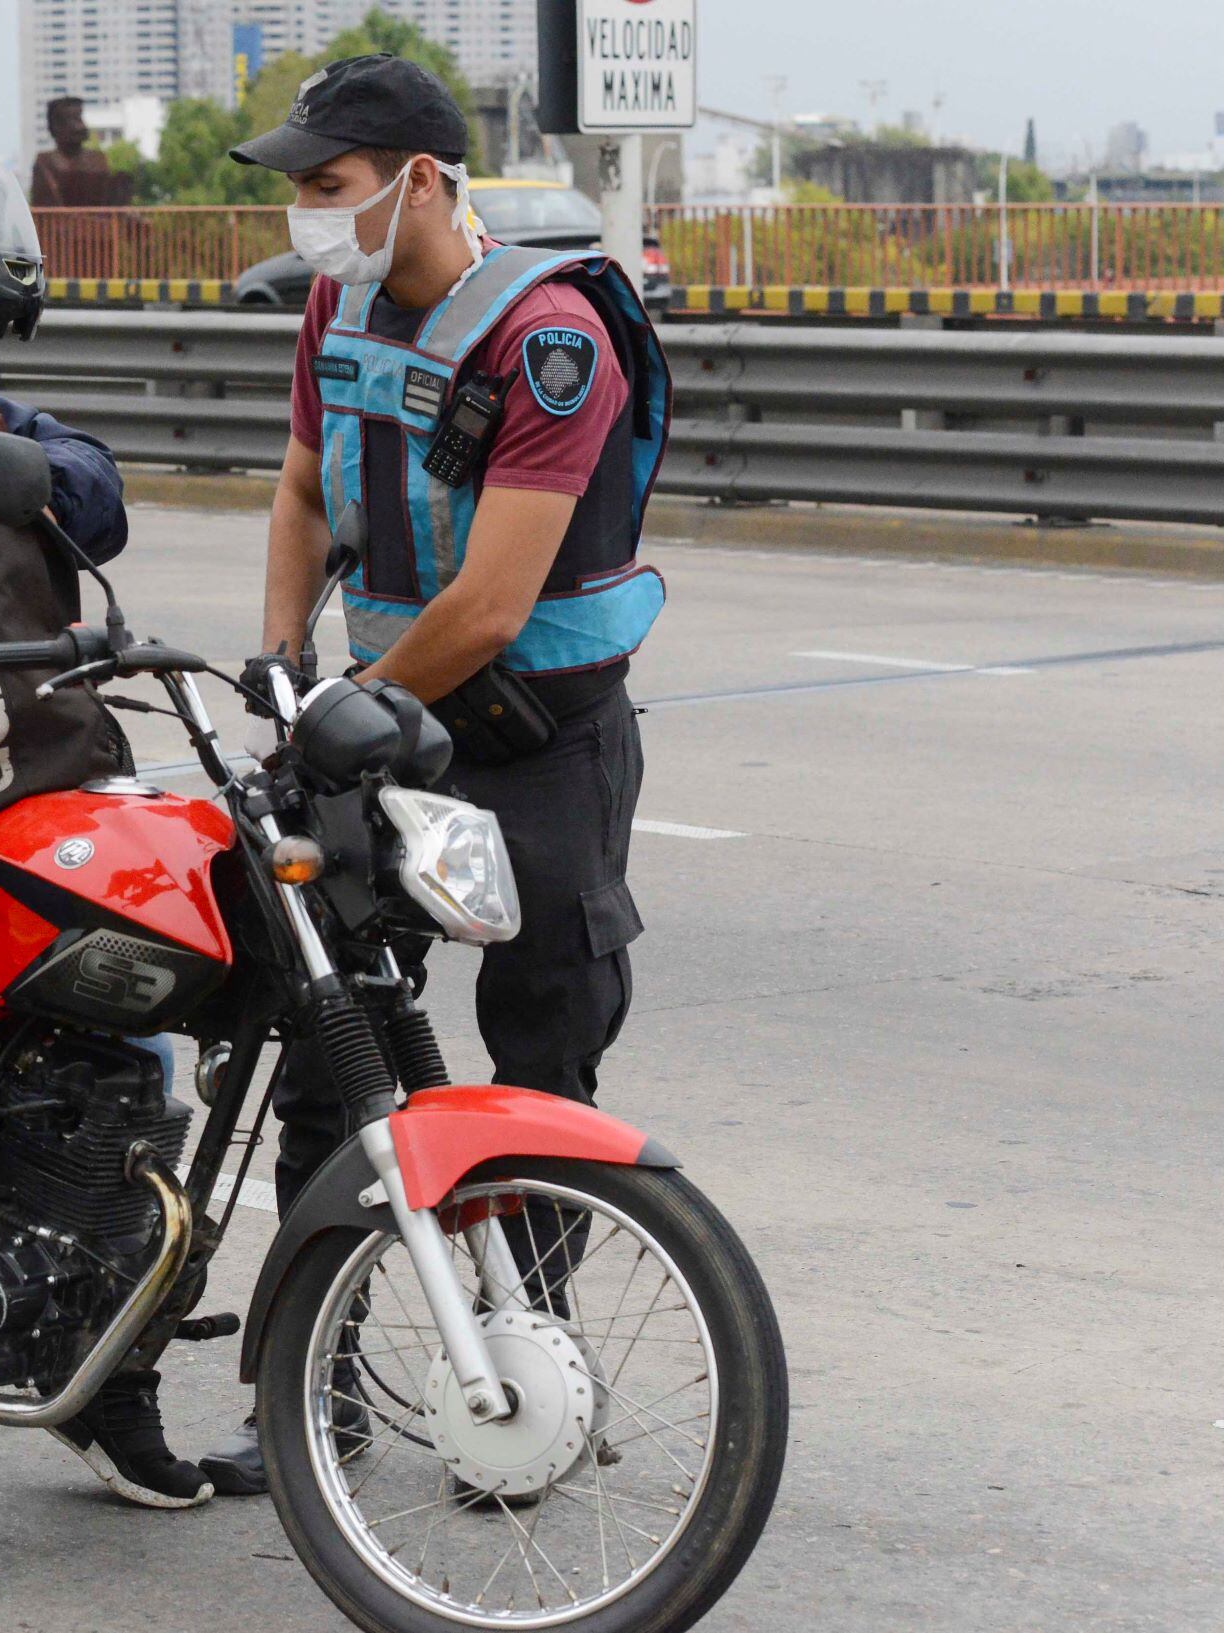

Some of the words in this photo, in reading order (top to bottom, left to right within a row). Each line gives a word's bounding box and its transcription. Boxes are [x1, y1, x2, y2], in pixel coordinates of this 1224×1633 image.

[586, 18, 691, 60] VELOCIDAD
[602, 70, 677, 111] MAXIMA
[538, 332, 582, 350] POLICIA
[410, 370, 441, 390] OFICIAL
